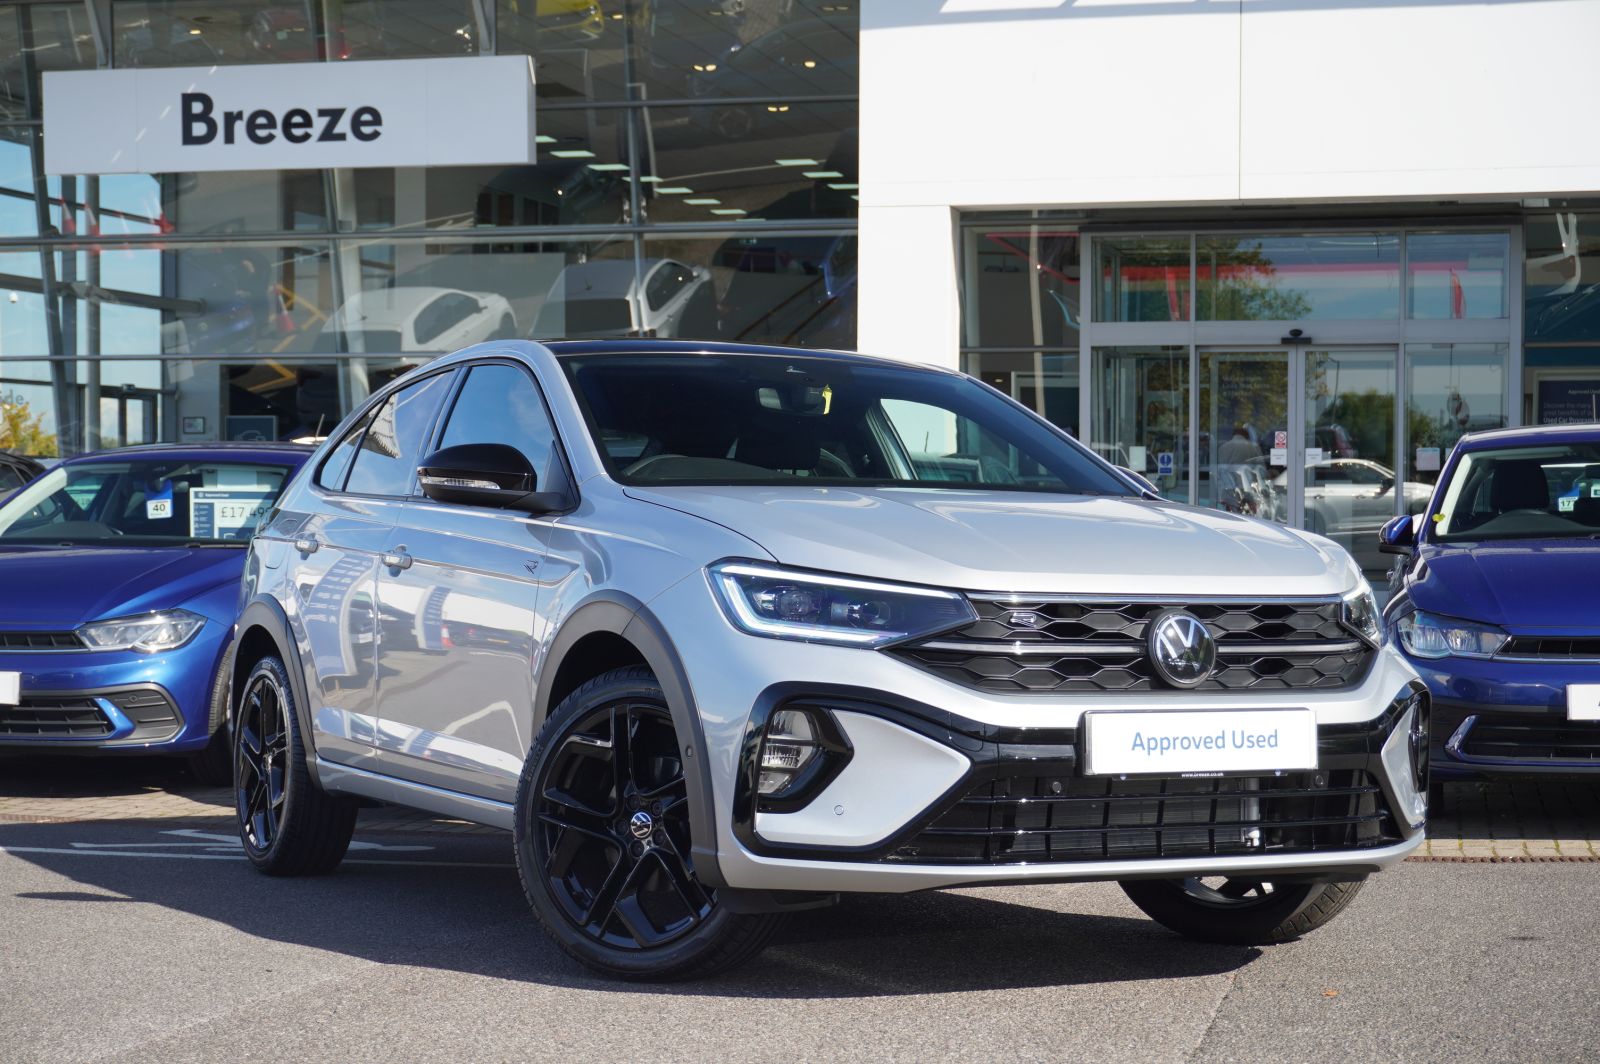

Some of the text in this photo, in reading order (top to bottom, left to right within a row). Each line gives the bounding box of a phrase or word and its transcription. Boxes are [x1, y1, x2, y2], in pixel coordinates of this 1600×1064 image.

[181, 92, 383, 146] Breeze
[153, 503, 166, 512] 40
[1131, 729, 1278, 756] Approved Used
